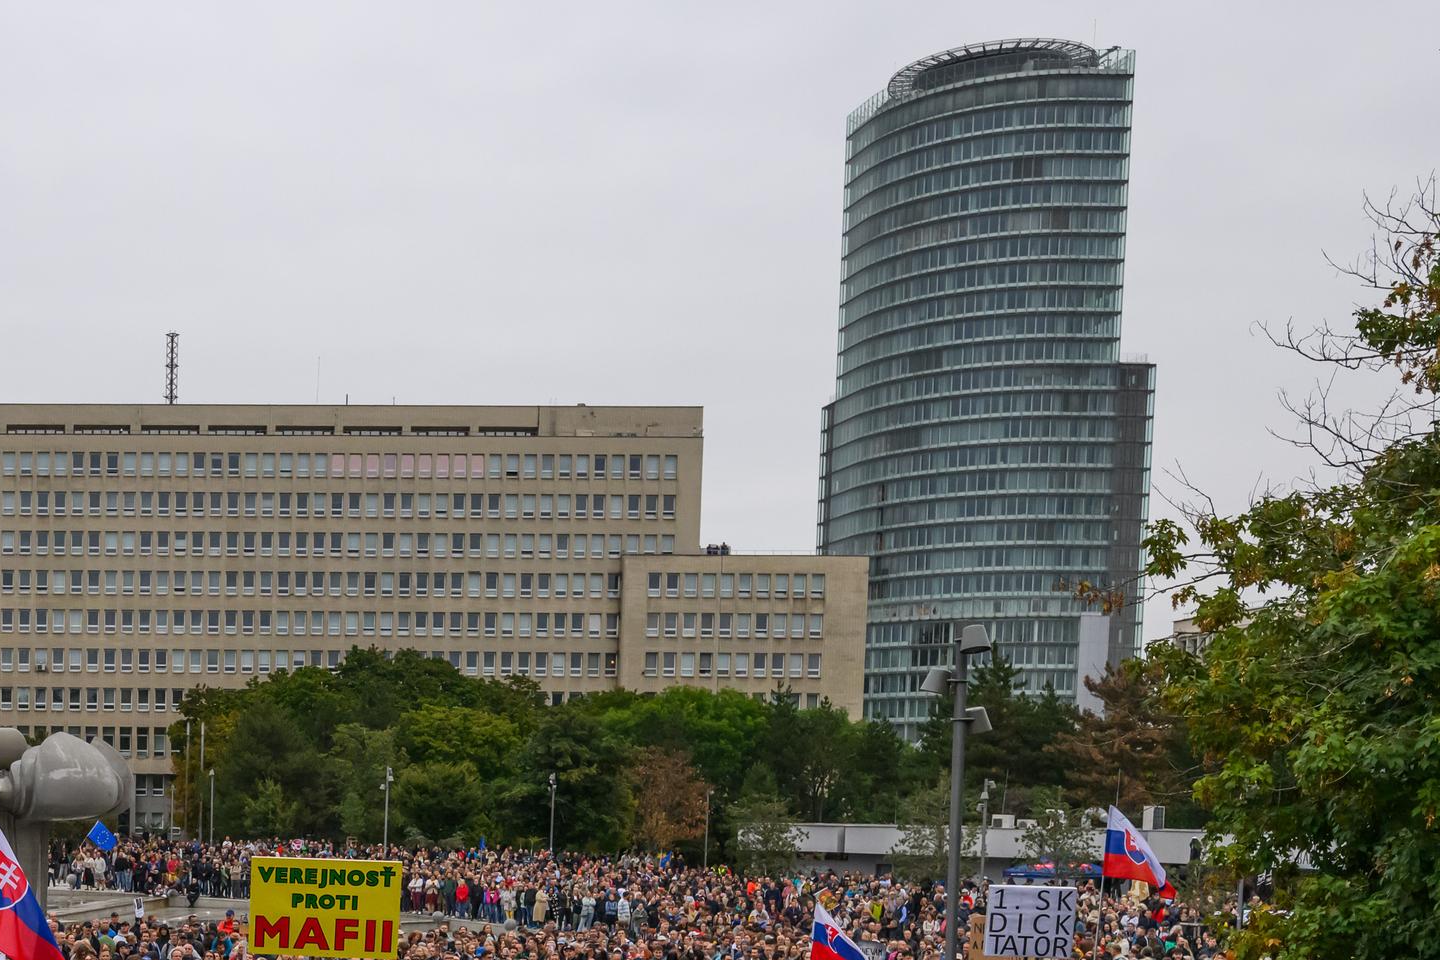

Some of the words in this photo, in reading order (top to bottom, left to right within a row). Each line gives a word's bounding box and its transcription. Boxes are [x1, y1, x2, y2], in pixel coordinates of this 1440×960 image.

[258, 866, 396, 888] VEREJNOSŤ
[291, 893, 358, 911] PROTI
[994, 889, 1020, 910] 1.
[1036, 890, 1073, 912] SK
[254, 915, 393, 953] MAFII
[988, 913, 1072, 935] DICK
[988, 934, 1068, 957] TATOR
